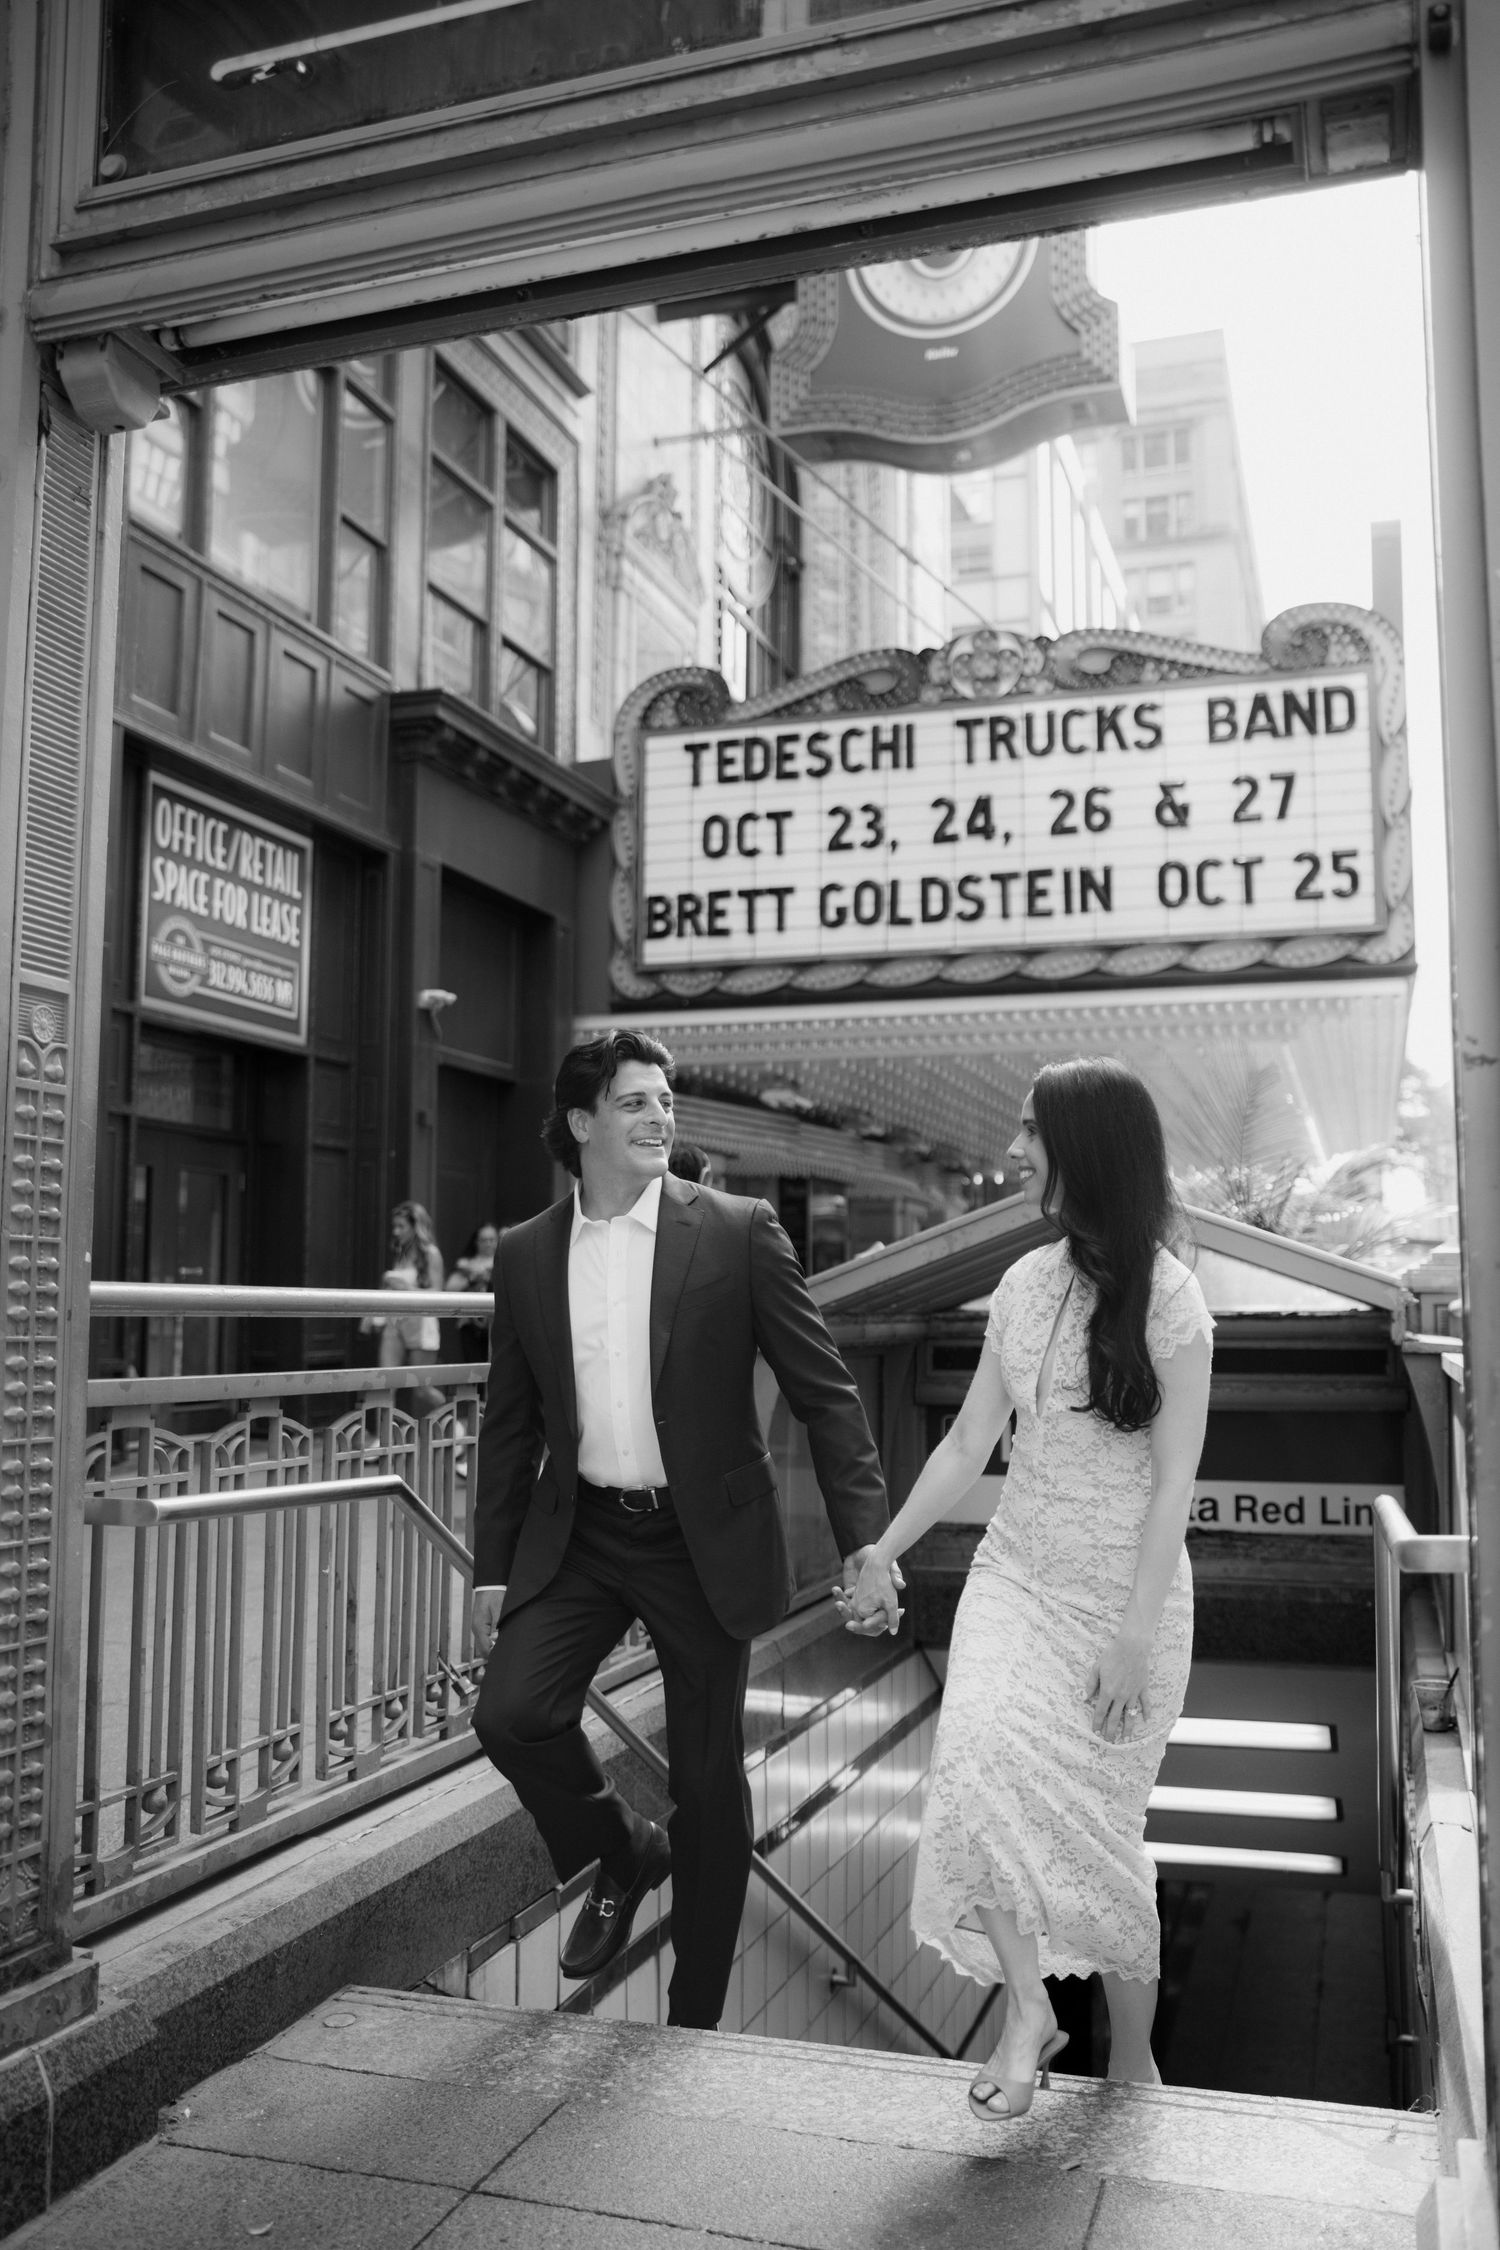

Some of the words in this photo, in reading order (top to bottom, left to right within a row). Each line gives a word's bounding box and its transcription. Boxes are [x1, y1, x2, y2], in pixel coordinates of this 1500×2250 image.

[684, 723, 914, 788] TEDESCHI
[956, 701, 1164, 765] TRUCKS
[1208, 685, 1357, 745] BAND
[155, 797, 302, 900] OFFICE/RETAIL
[702, 810, 793, 859] OCT
[827, 804, 898, 855] 23,
[931, 793, 1013, 847] 24,
[1050, 786, 1112, 836] 26
[1154, 778, 1190, 829] &
[1232, 771, 1297, 824] 27
[152, 855, 210, 917] SPACE
[211, 876, 249, 930] FOR
[250, 890, 302, 948] LEASE
[646, 886, 795, 940] BRETT
[819, 864, 1112, 929] GOLDSTEIN
[1158, 855, 1264, 908] OCT
[1293, 849, 1360, 901] 25
[1234, 1494, 1305, 1525] Red
